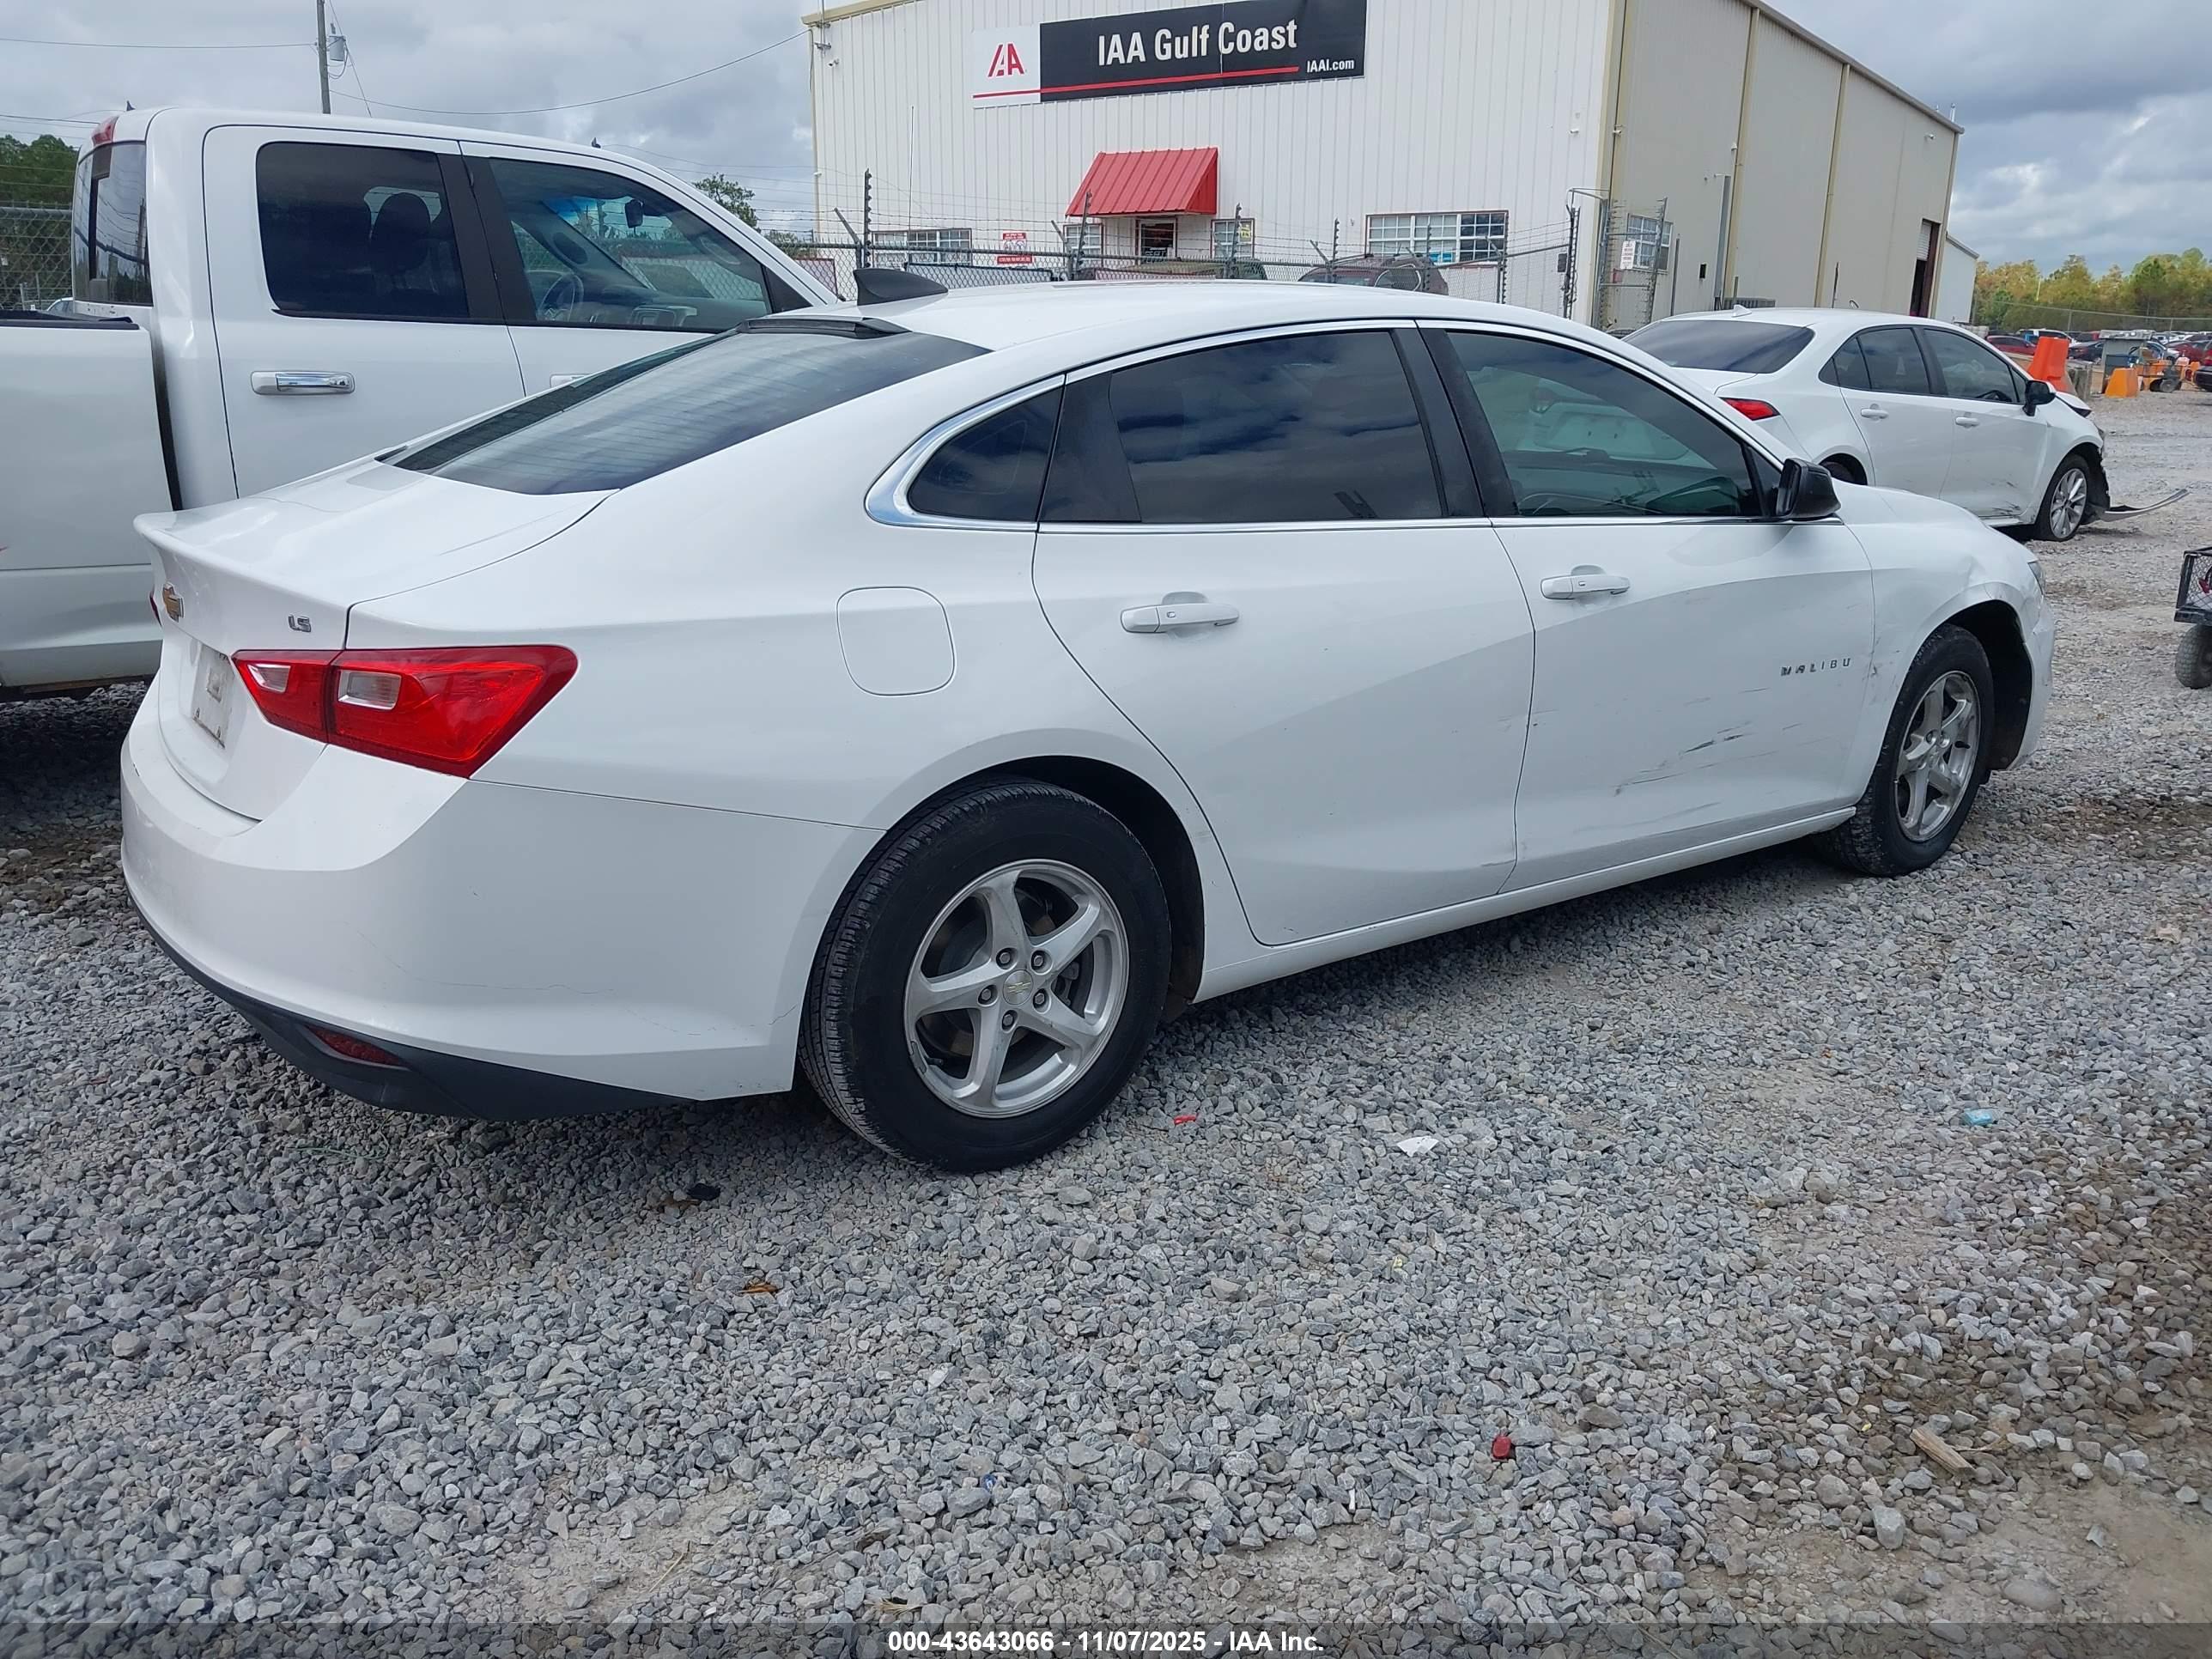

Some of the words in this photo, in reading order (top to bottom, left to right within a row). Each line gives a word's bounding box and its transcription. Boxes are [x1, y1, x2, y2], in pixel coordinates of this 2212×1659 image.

[1098, 32, 1146, 66] IAA
[1155, 24, 1210, 61] Gulf
[1218, 19, 1297, 55] Coast
[1306, 58, 1355, 73] IAAI.com
[289, 615, 312, 633] LS
[1780, 658, 1850, 677] MALIBU
